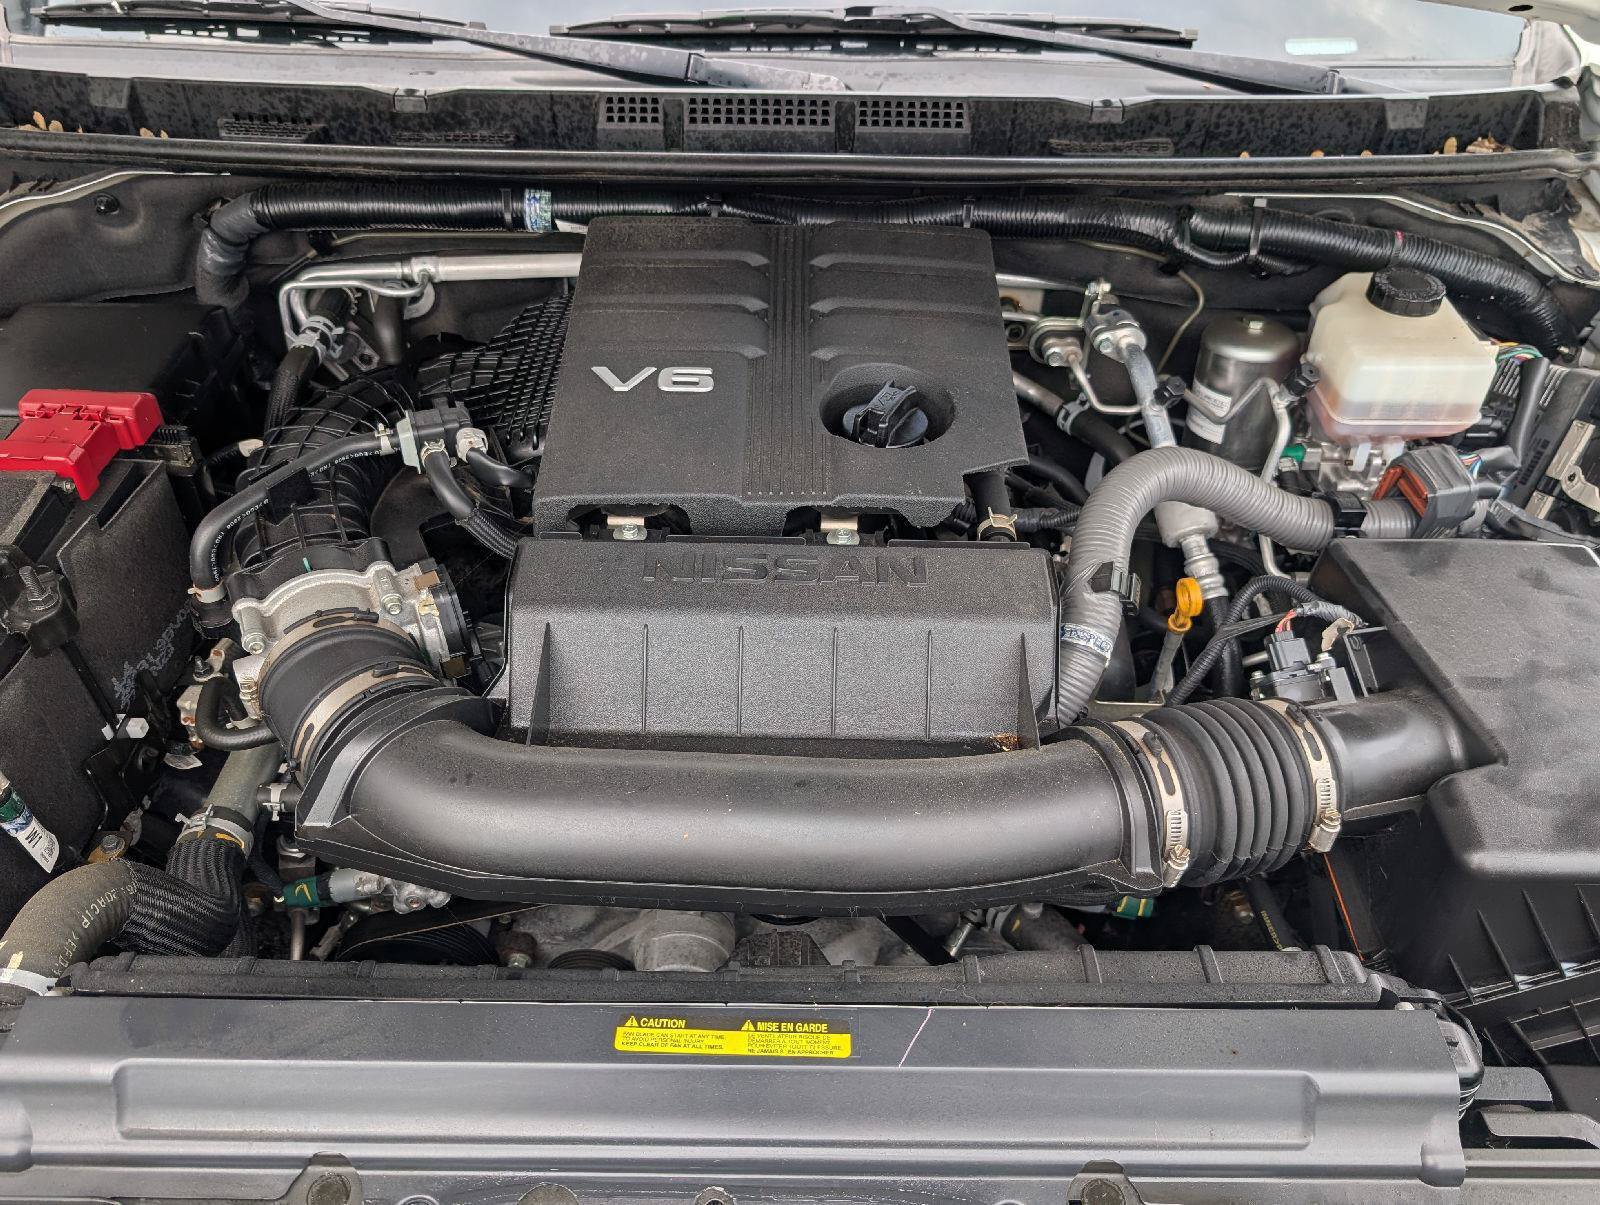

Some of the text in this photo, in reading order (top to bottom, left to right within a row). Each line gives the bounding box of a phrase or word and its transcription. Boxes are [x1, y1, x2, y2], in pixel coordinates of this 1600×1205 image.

[590, 366, 715, 393] V6
[642, 552, 929, 587] NISSAN
[640, 1017, 686, 1029] CAUTION
[757, 1021, 829, 1034] MISE EN GARDE
